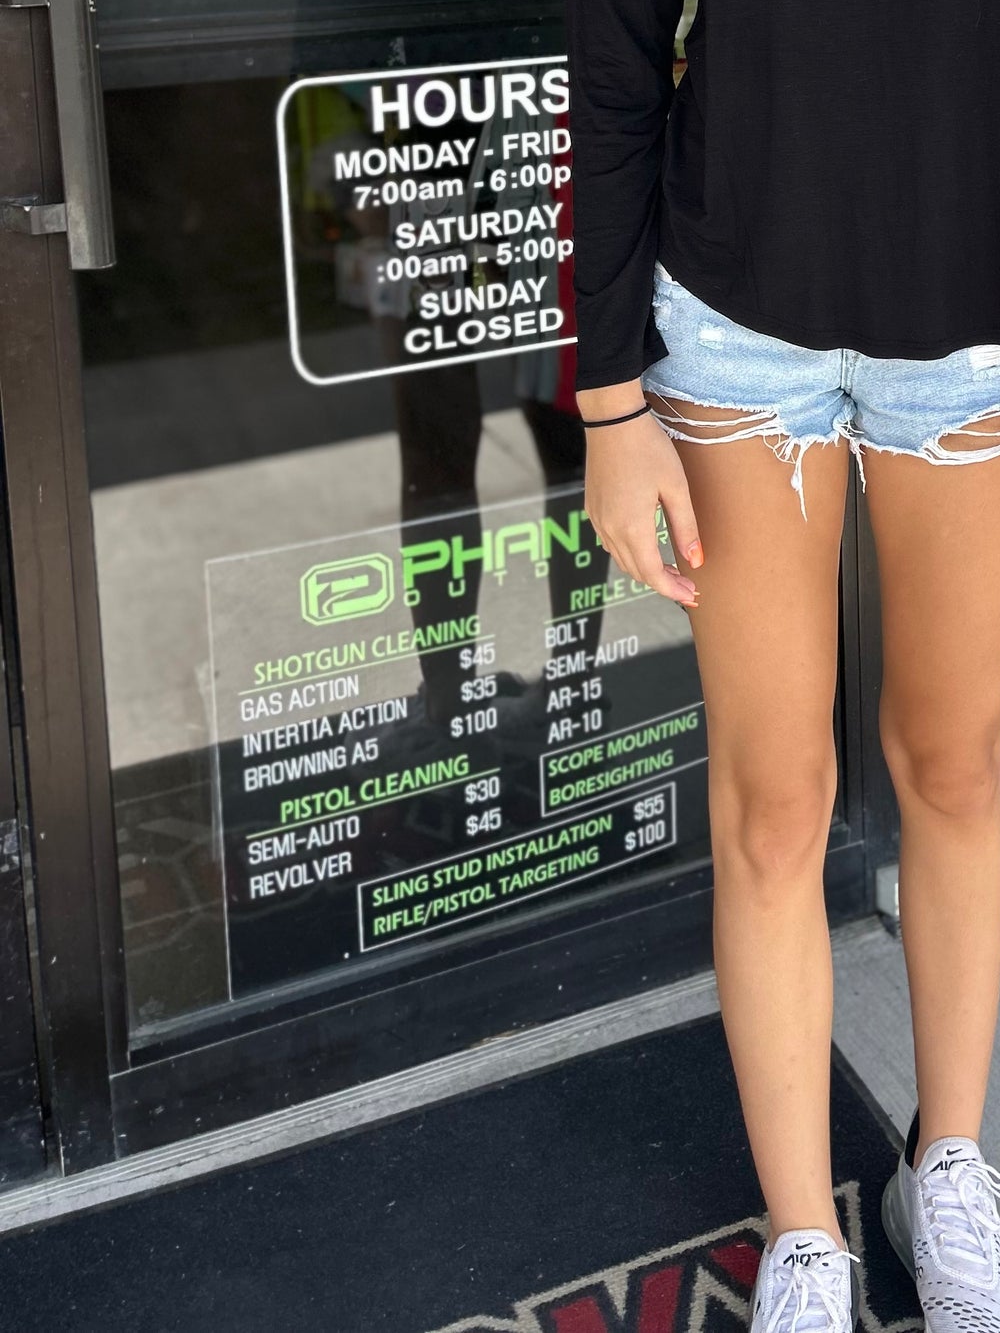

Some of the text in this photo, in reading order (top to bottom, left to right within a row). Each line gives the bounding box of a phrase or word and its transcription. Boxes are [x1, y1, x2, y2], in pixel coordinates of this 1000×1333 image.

[370, 69, 570, 134] HOURS
[334, 138, 477, 180] MONDAY
[354, 177, 464, 211] 7:00am
[395, 202, 564, 250] SATURDAY
[419, 275, 548, 321] SUNDAY
[404, 306, 565, 354] CLOSED
[570, 578, 626, 611] RIFLE
[254, 615, 482, 686] SHOTGUN CLEANING
[544, 617, 588, 649] BOLT
[545, 635, 639, 681] SEMI-AUTO
[240, 642, 496, 722] GAS ACTION $45
[546, 677, 602, 713] AR-15
[243, 675, 497, 757] INTERTIA ACTION $35
[548, 708, 603, 744] AR-10
[548, 712, 699, 777] SCOPE MOUNTING
[244, 707, 498, 792] BROWNING A5 $100
[549, 749, 674, 806] BORESIGHTING
[280, 754, 470, 823] PISTOL CLEANING
[248, 776, 500, 865] SEMI-AUTO $30
[372, 793, 665, 907] SLING STUD INSTALLATION $55
[250, 808, 502, 899] REVOLVER $45
[373, 819, 666, 936] RIFLE/PISTOL TARGETING $100
